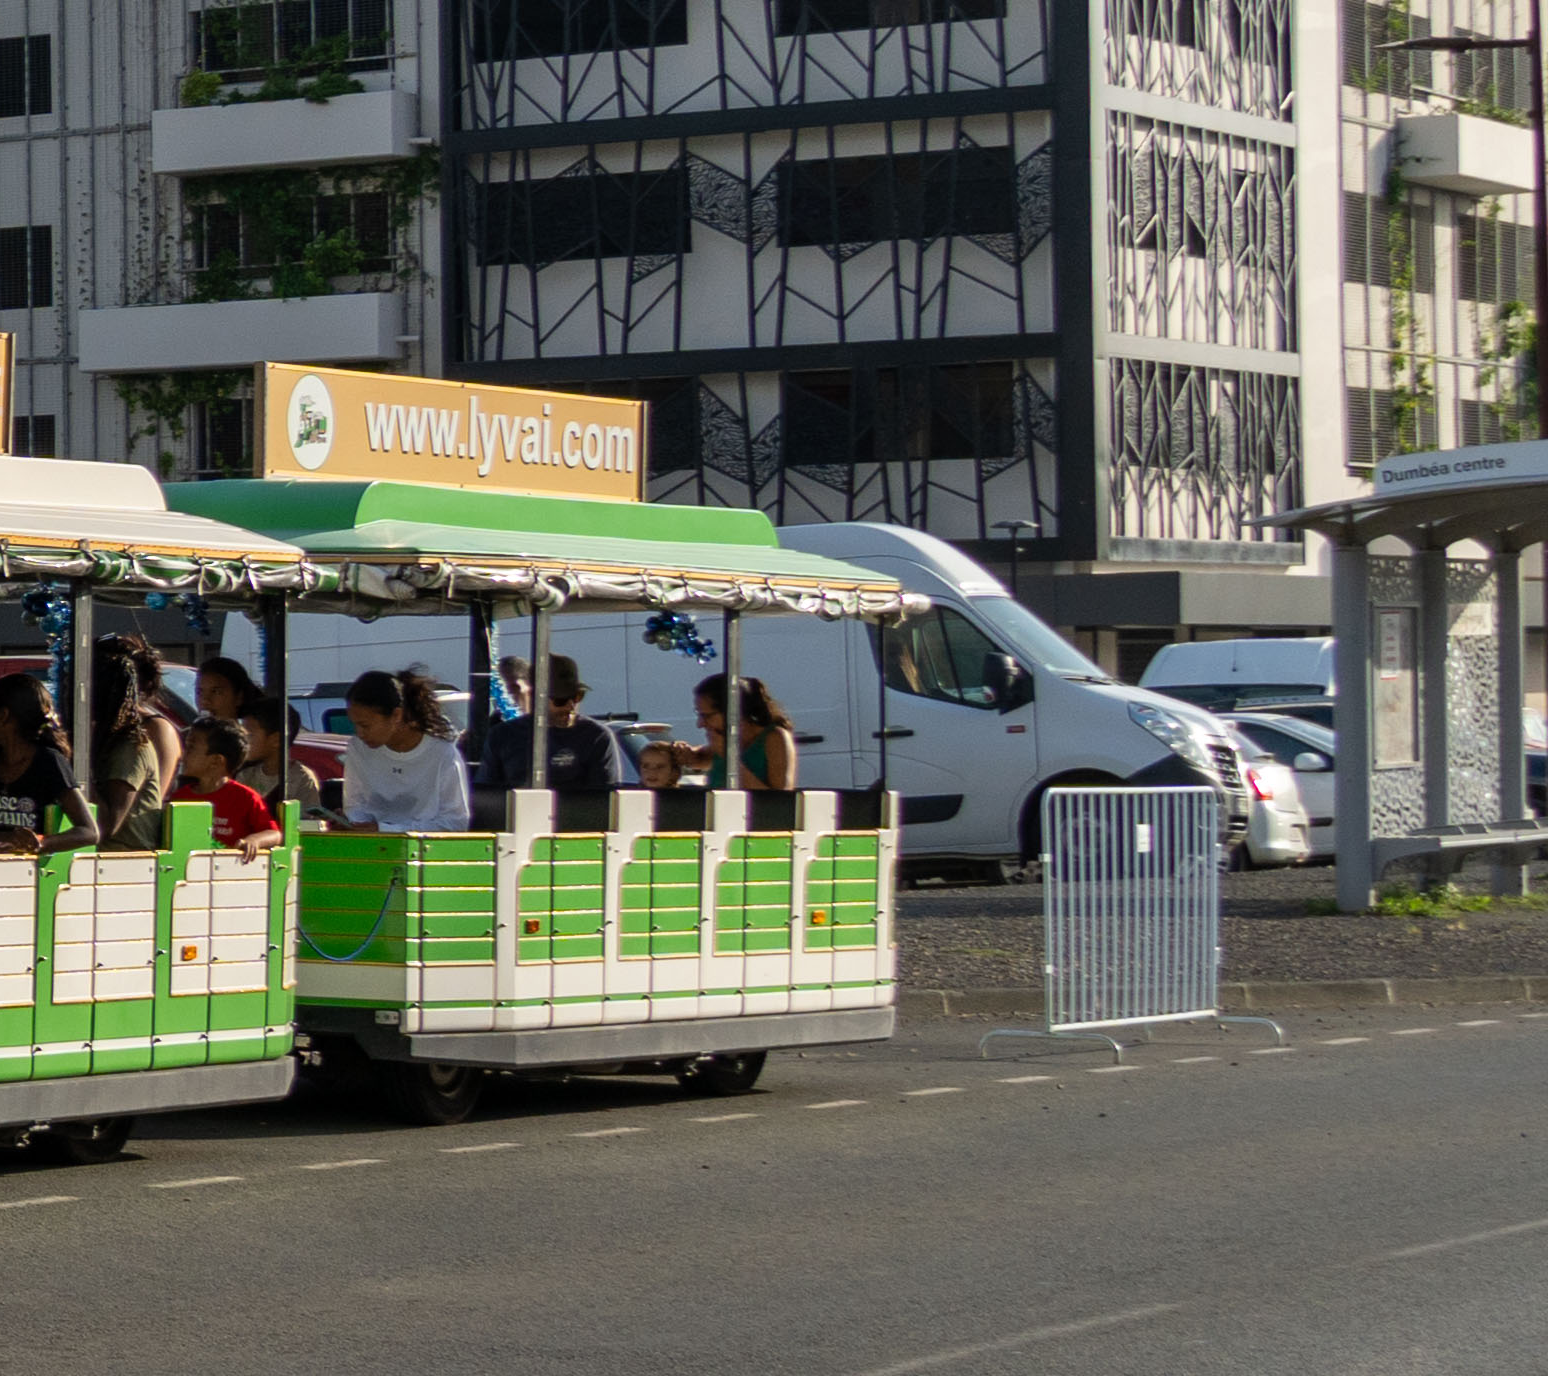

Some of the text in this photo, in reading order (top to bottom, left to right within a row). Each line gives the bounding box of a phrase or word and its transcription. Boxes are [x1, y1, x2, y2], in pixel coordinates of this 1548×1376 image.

[364, 395, 635, 476] www.lyvai.com
[1382, 457, 1506, 483] Dumbéa centre
